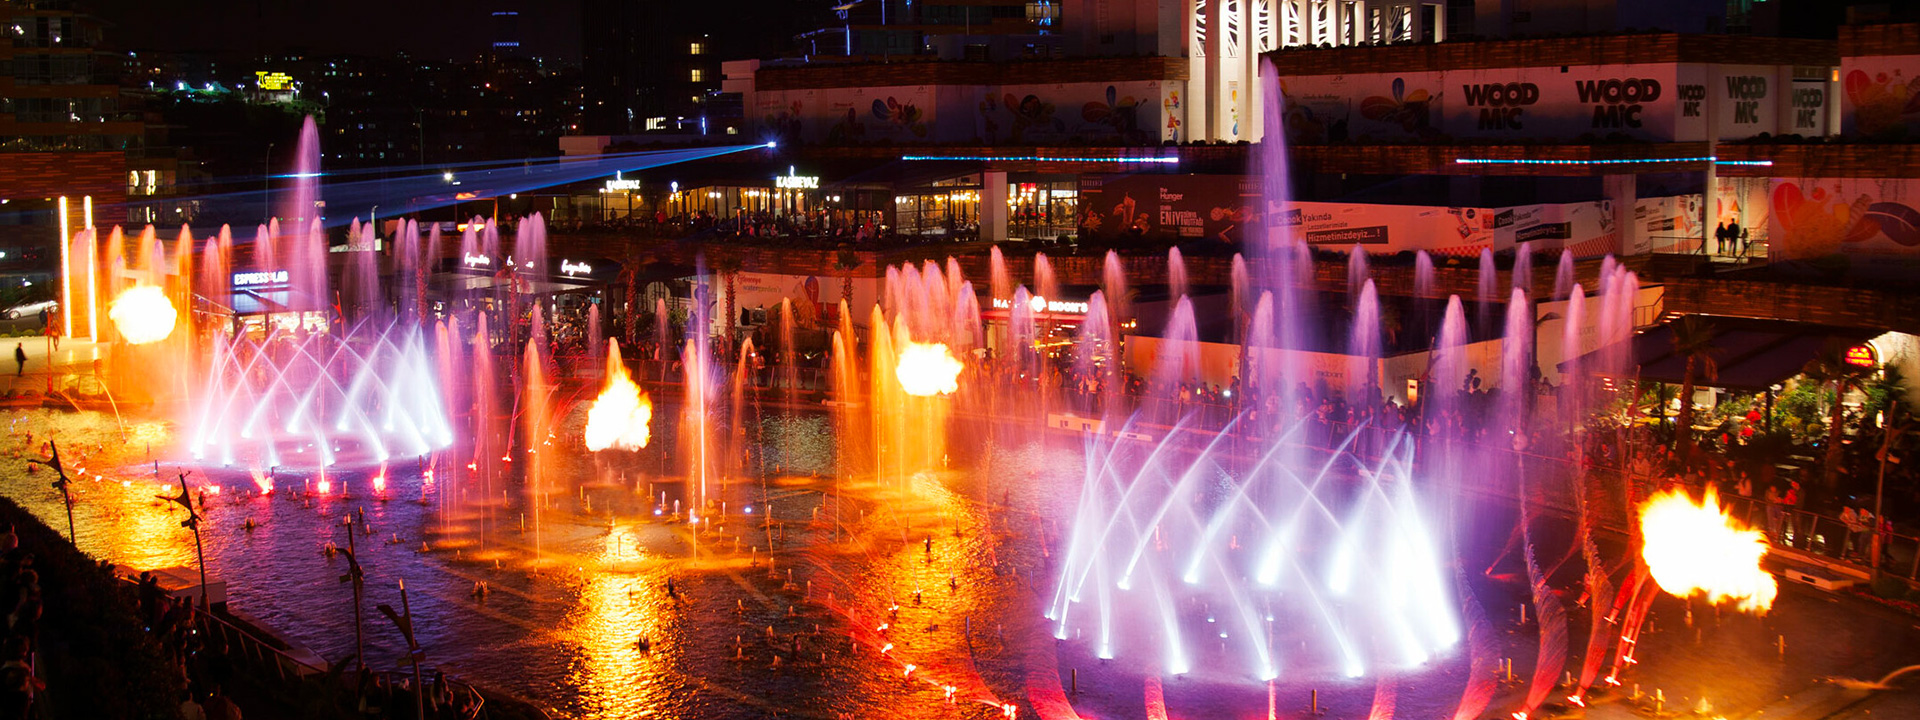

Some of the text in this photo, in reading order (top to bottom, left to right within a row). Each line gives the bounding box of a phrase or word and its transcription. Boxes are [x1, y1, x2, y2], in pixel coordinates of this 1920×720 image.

[1463, 82, 1540, 107] WOOD
[1576, 77, 1662, 104] WOOD
[1677, 84, 1706, 100] WOOD
[1726, 76, 1767, 99] WOOD
[1792, 88, 1823, 108] WOOD
[1160, 193, 1183, 201] Hunger
[1302, 213, 1332, 222] Yakında
